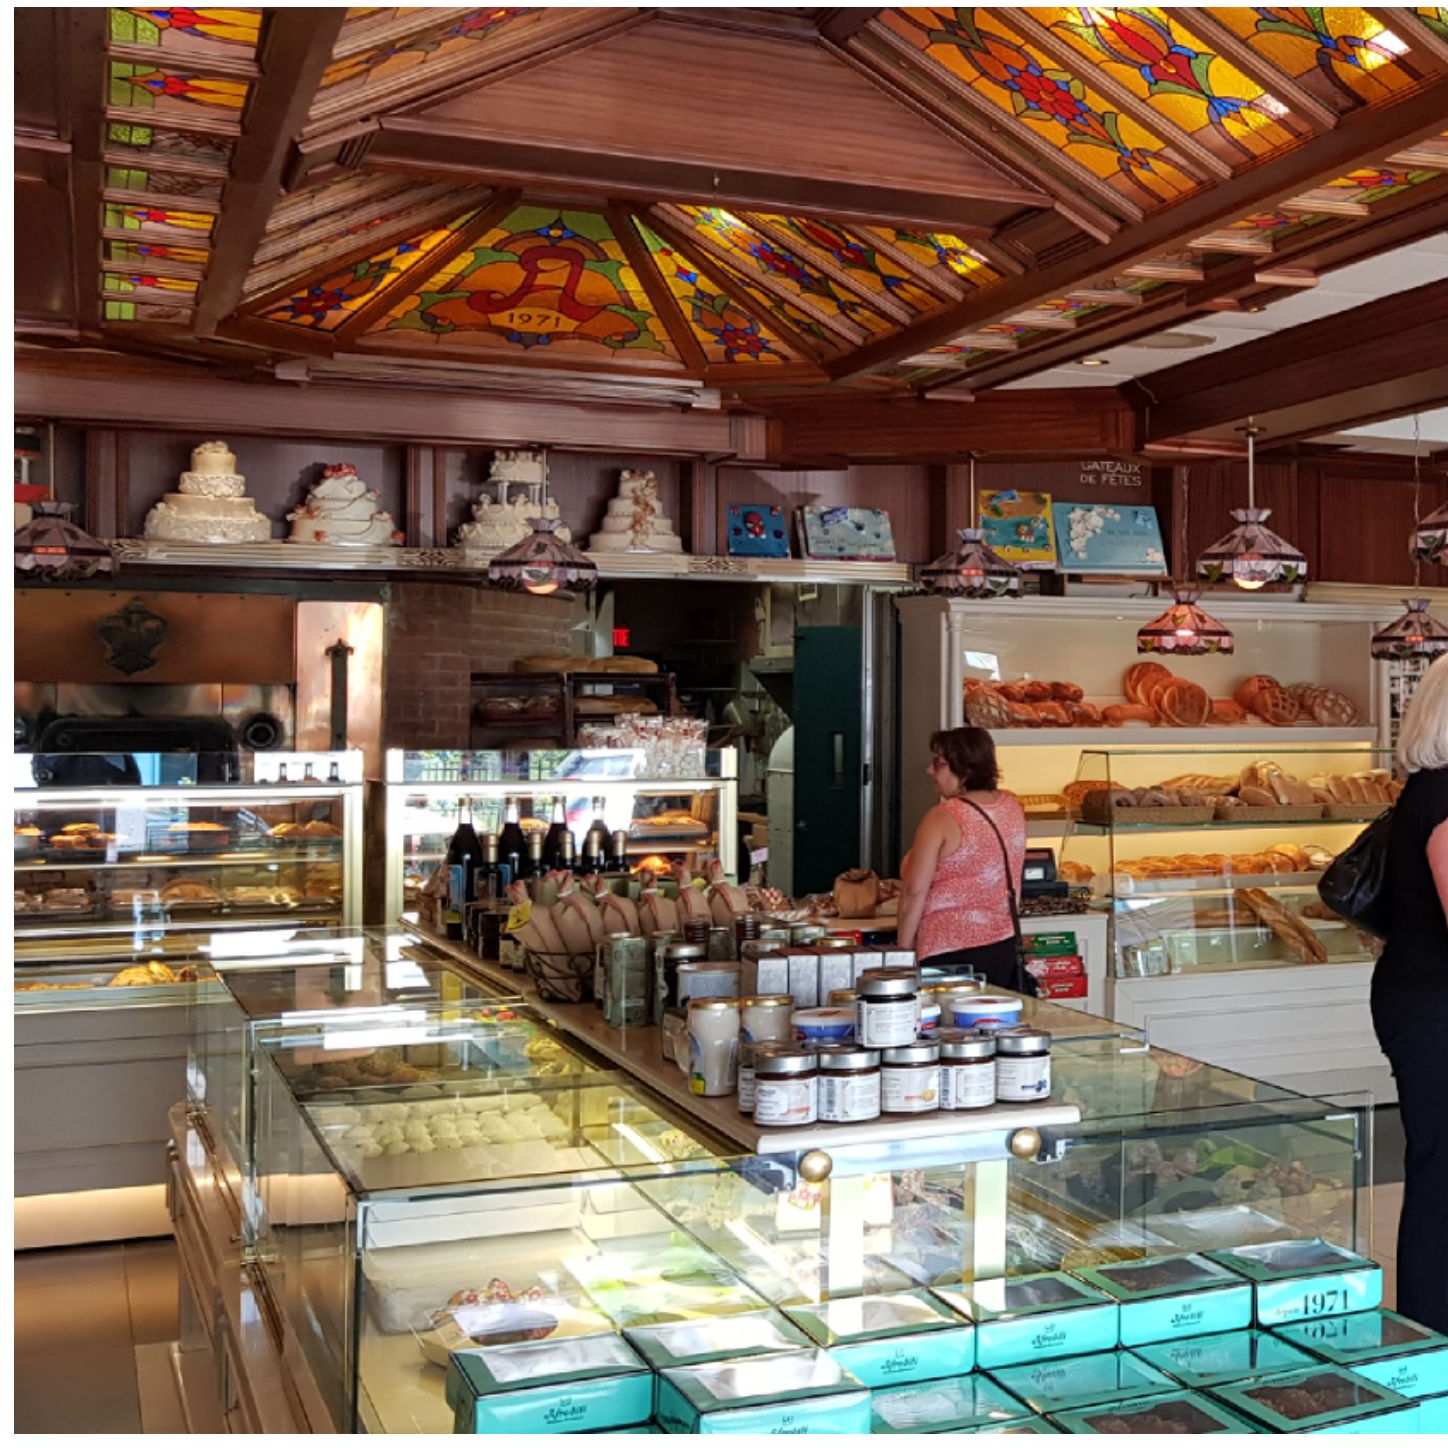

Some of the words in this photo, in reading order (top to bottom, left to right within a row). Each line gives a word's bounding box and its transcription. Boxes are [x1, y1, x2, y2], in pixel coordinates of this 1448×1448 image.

[508, 312, 560, 329] 1971
[1080, 473, 1098, 485] DE
[1303, 1288, 1348, 1315] 1971
